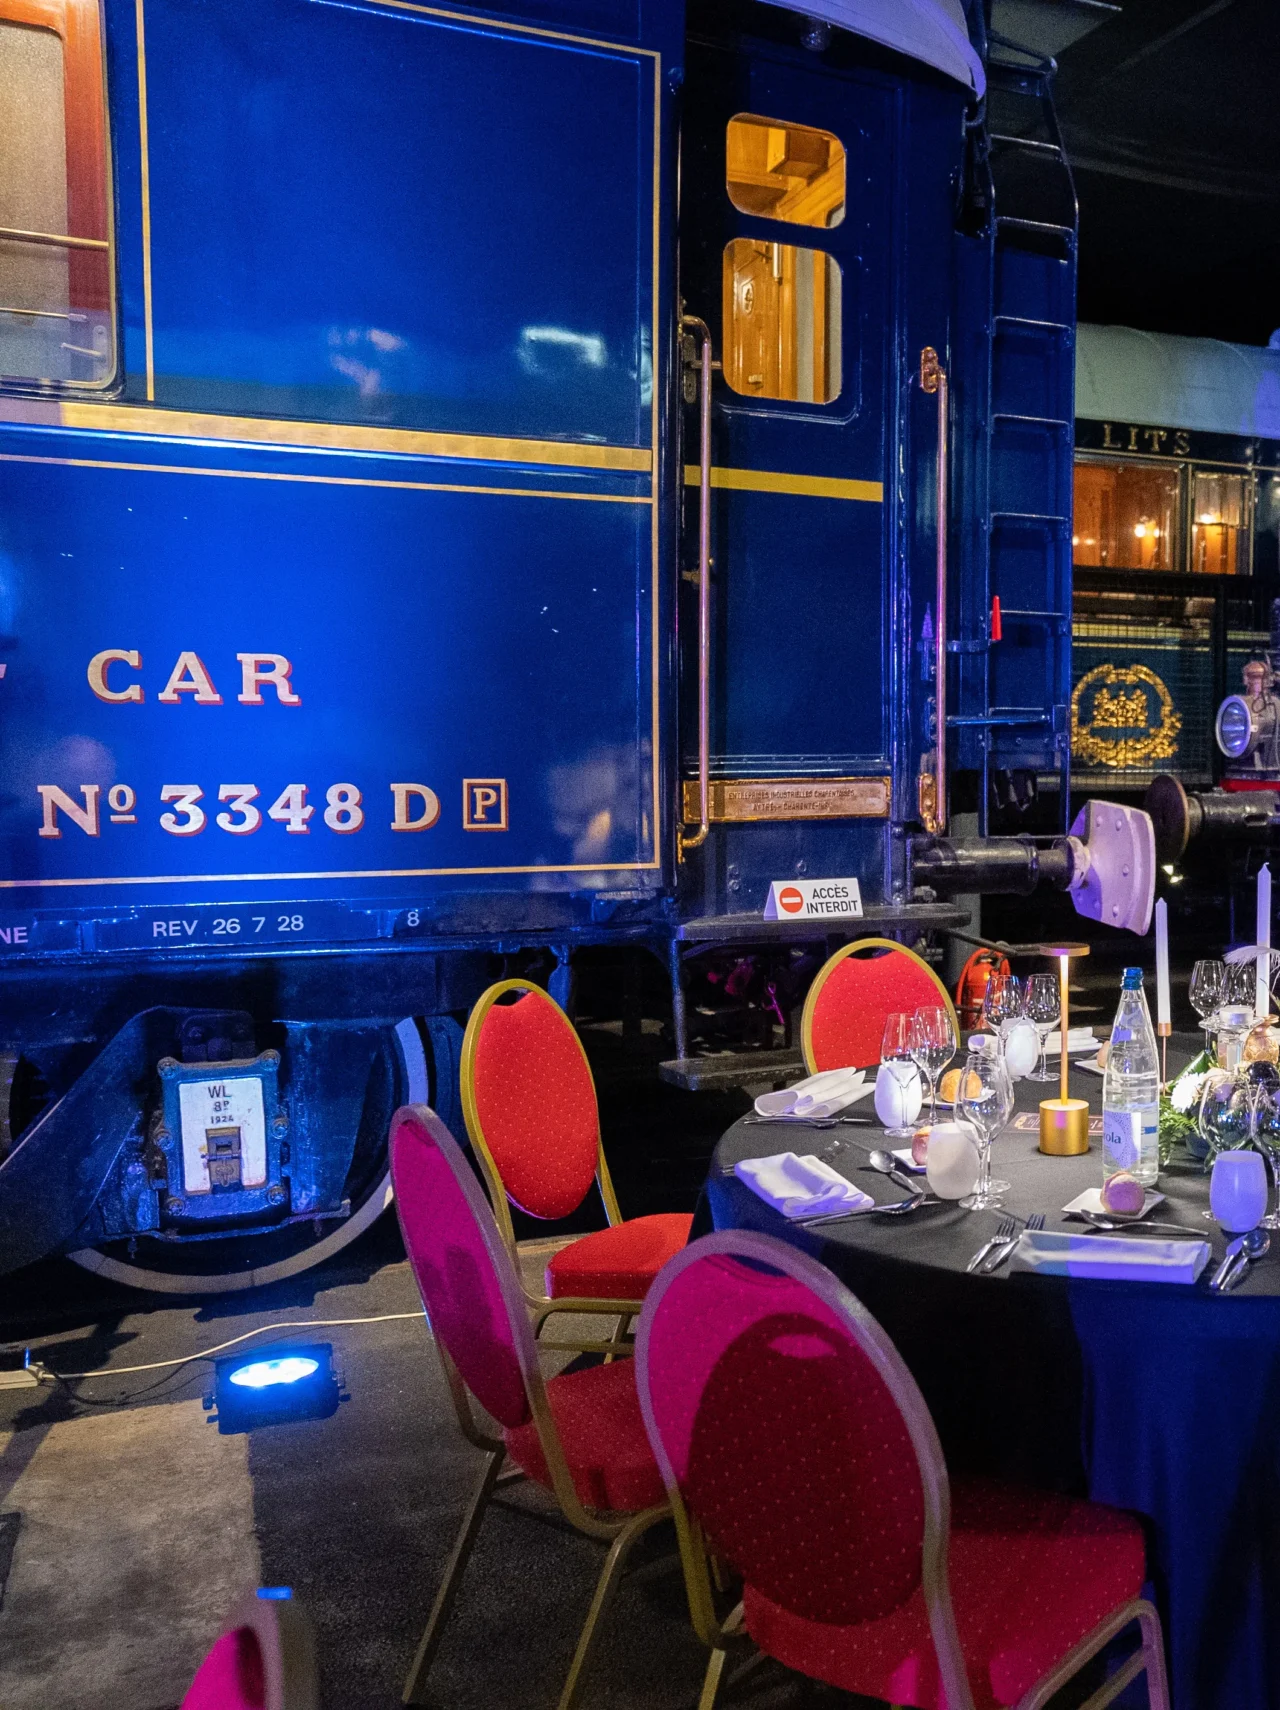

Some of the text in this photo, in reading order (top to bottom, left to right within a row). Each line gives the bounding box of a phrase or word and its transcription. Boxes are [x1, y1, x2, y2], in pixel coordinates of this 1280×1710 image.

[1103, 423, 1190, 455] LITS
[87, 649, 302, 706] CAR
[159, 783, 365, 835] 3348
[389, 783, 441, 832] D
[812, 884, 849, 900] ACCÈS
[806, 900, 858, 914] INTERDIT
[152, 915, 305, 938] REV 26 7 28
[406, 911, 420, 927] 8
[208, 1085, 232, 1099] WL
